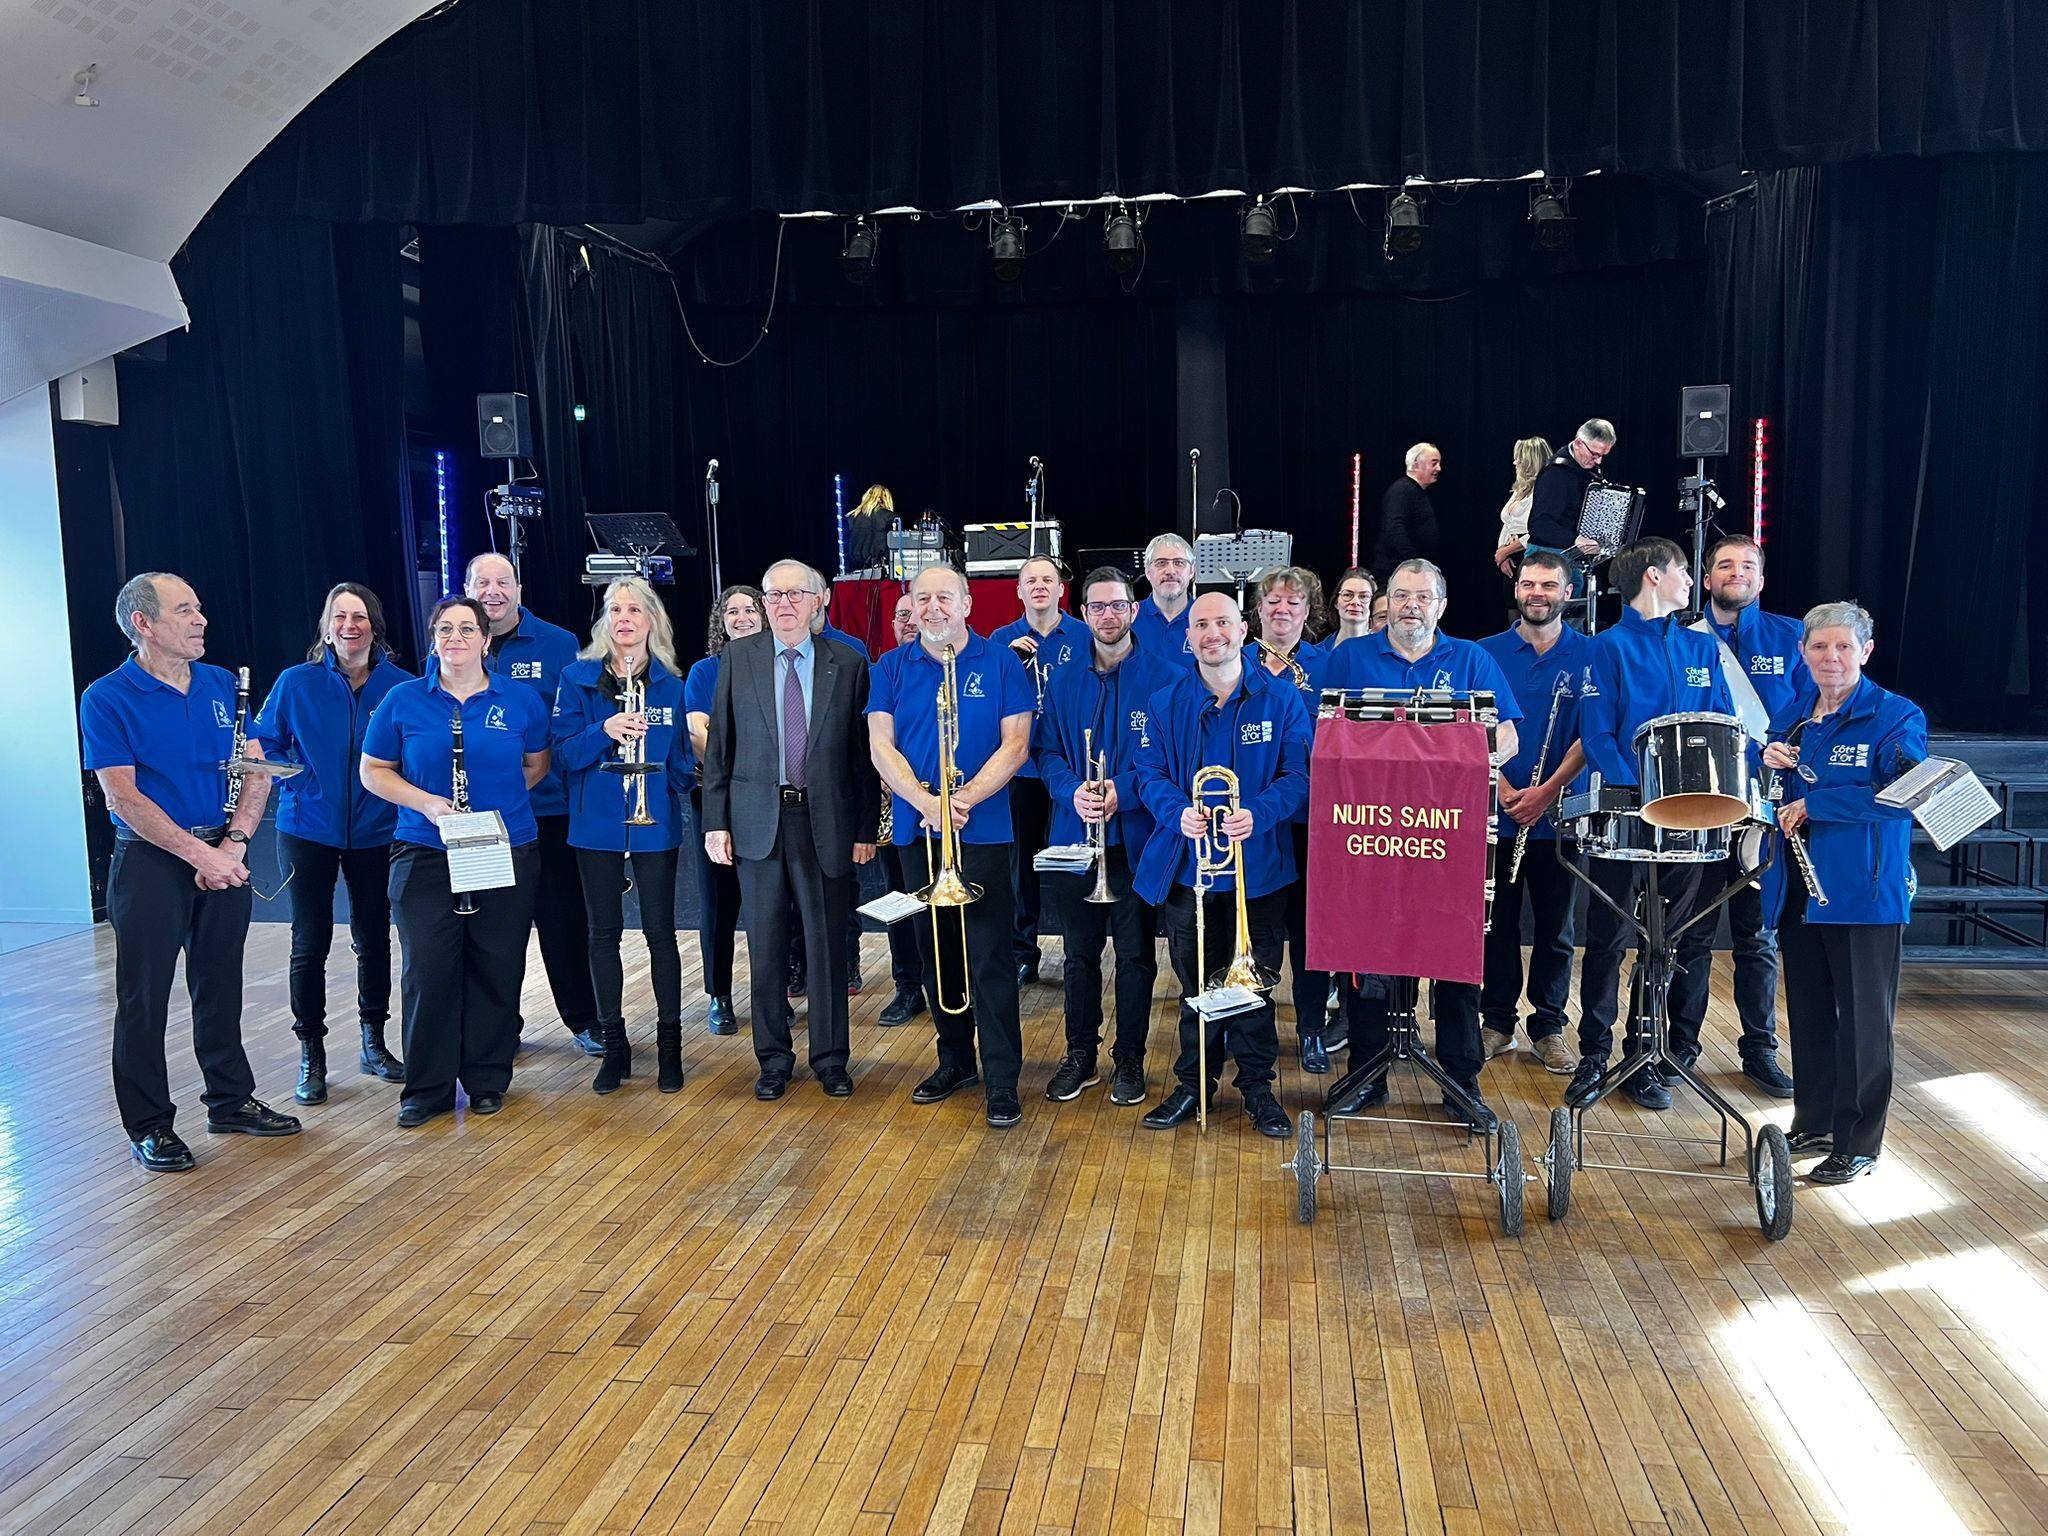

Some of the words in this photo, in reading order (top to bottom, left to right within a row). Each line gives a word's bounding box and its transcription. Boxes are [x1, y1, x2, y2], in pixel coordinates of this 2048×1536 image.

[1751, 655, 1772, 664] Côte
[1241, 723, 1261, 732] Côte
[1241, 731, 1261, 741] d'Or
[1832, 744, 1856, 754] Côte
[1829, 753, 1855, 762] d'Or
[1333, 803, 1392, 827] NUITS
[1400, 806, 1463, 830] SAINT
[1346, 833, 1446, 860] GEORGES
